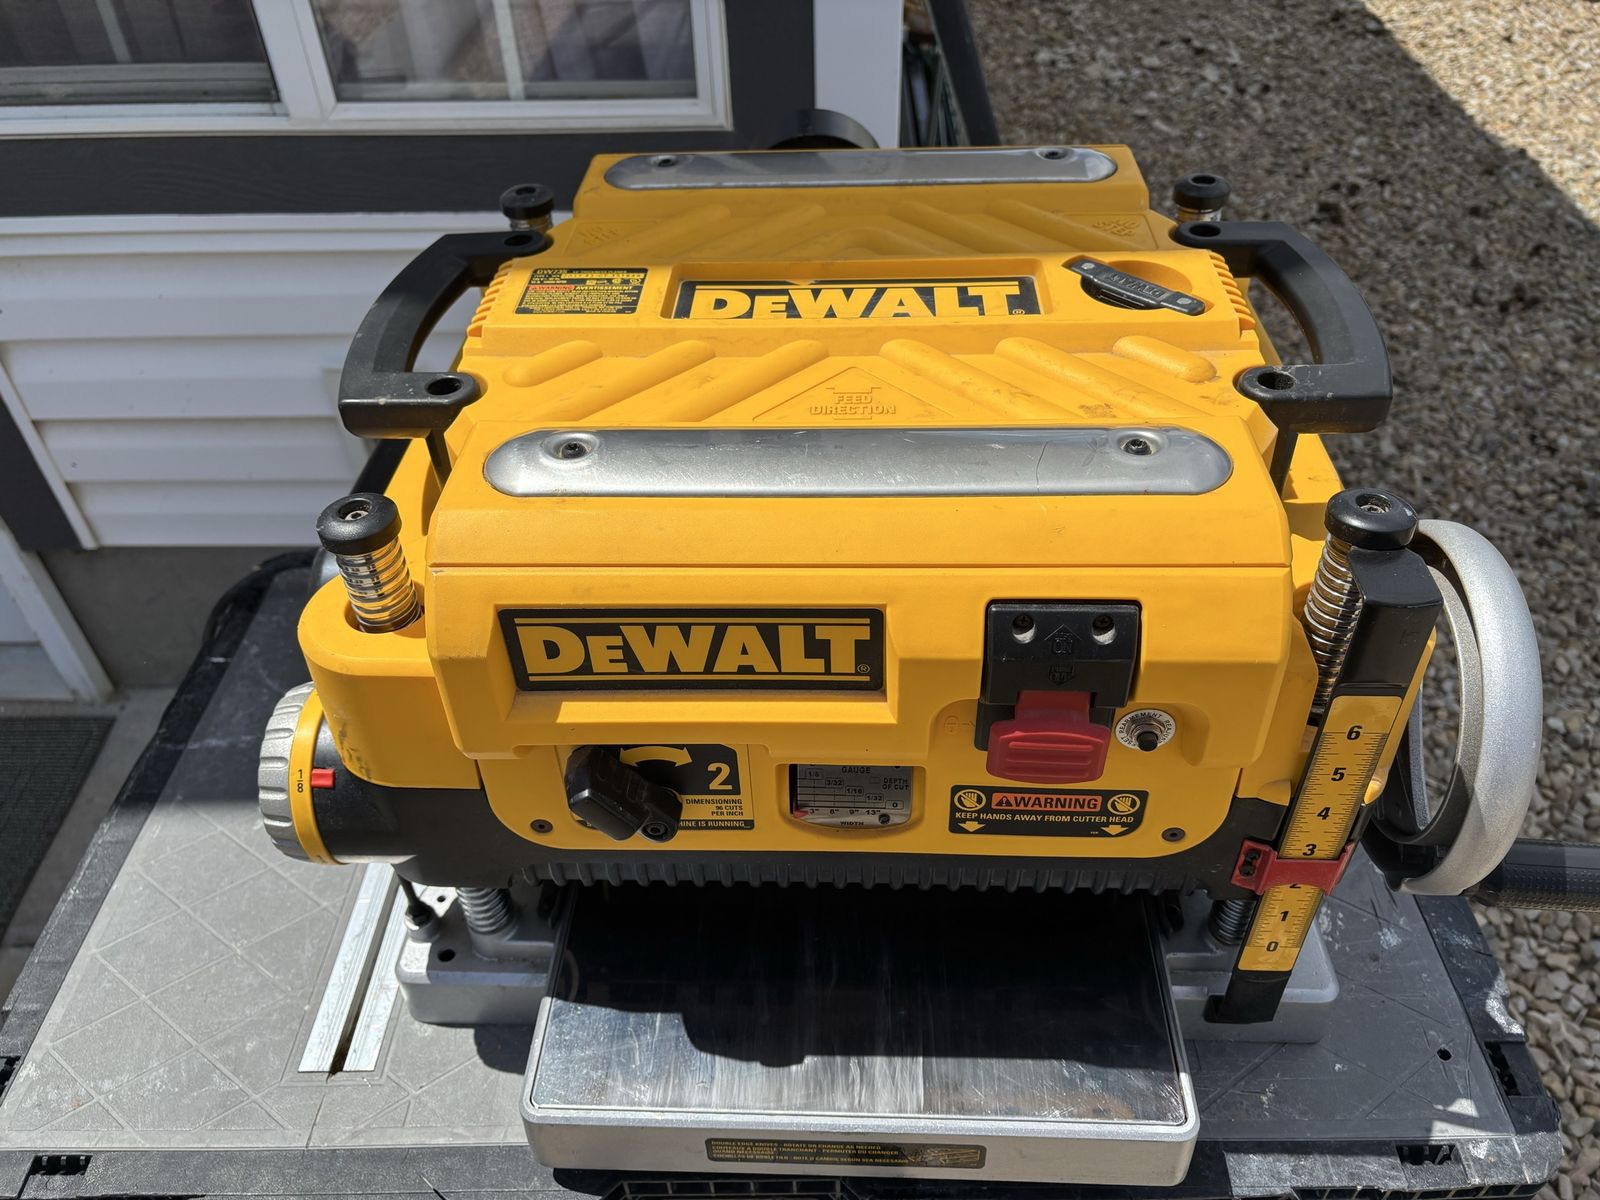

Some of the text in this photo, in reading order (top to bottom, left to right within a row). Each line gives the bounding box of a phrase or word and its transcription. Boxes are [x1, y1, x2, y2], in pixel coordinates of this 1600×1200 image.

[836, 395, 872, 405] FEED
[809, 405, 897, 415] DIRECTION
[1346, 725, 1363, 741] 6
[841, 766, 871, 774] GAUGE
[1331, 767, 1347, 782] 5
[707, 762, 733, 790] 2
[1014, 796, 1098, 810] WARNING
[980, 812, 1012, 821] HANDS
[1014, 813, 1042, 822] AWAY
[1044, 814, 1071, 822] FROM
[1072, 815, 1107, 823] CUTTER
[1317, 806, 1331, 820] 4
[1302, 844, 1317, 856] 3
[1280, 911, 1289, 922] 1
[1266, 941, 1279, 952] 0
